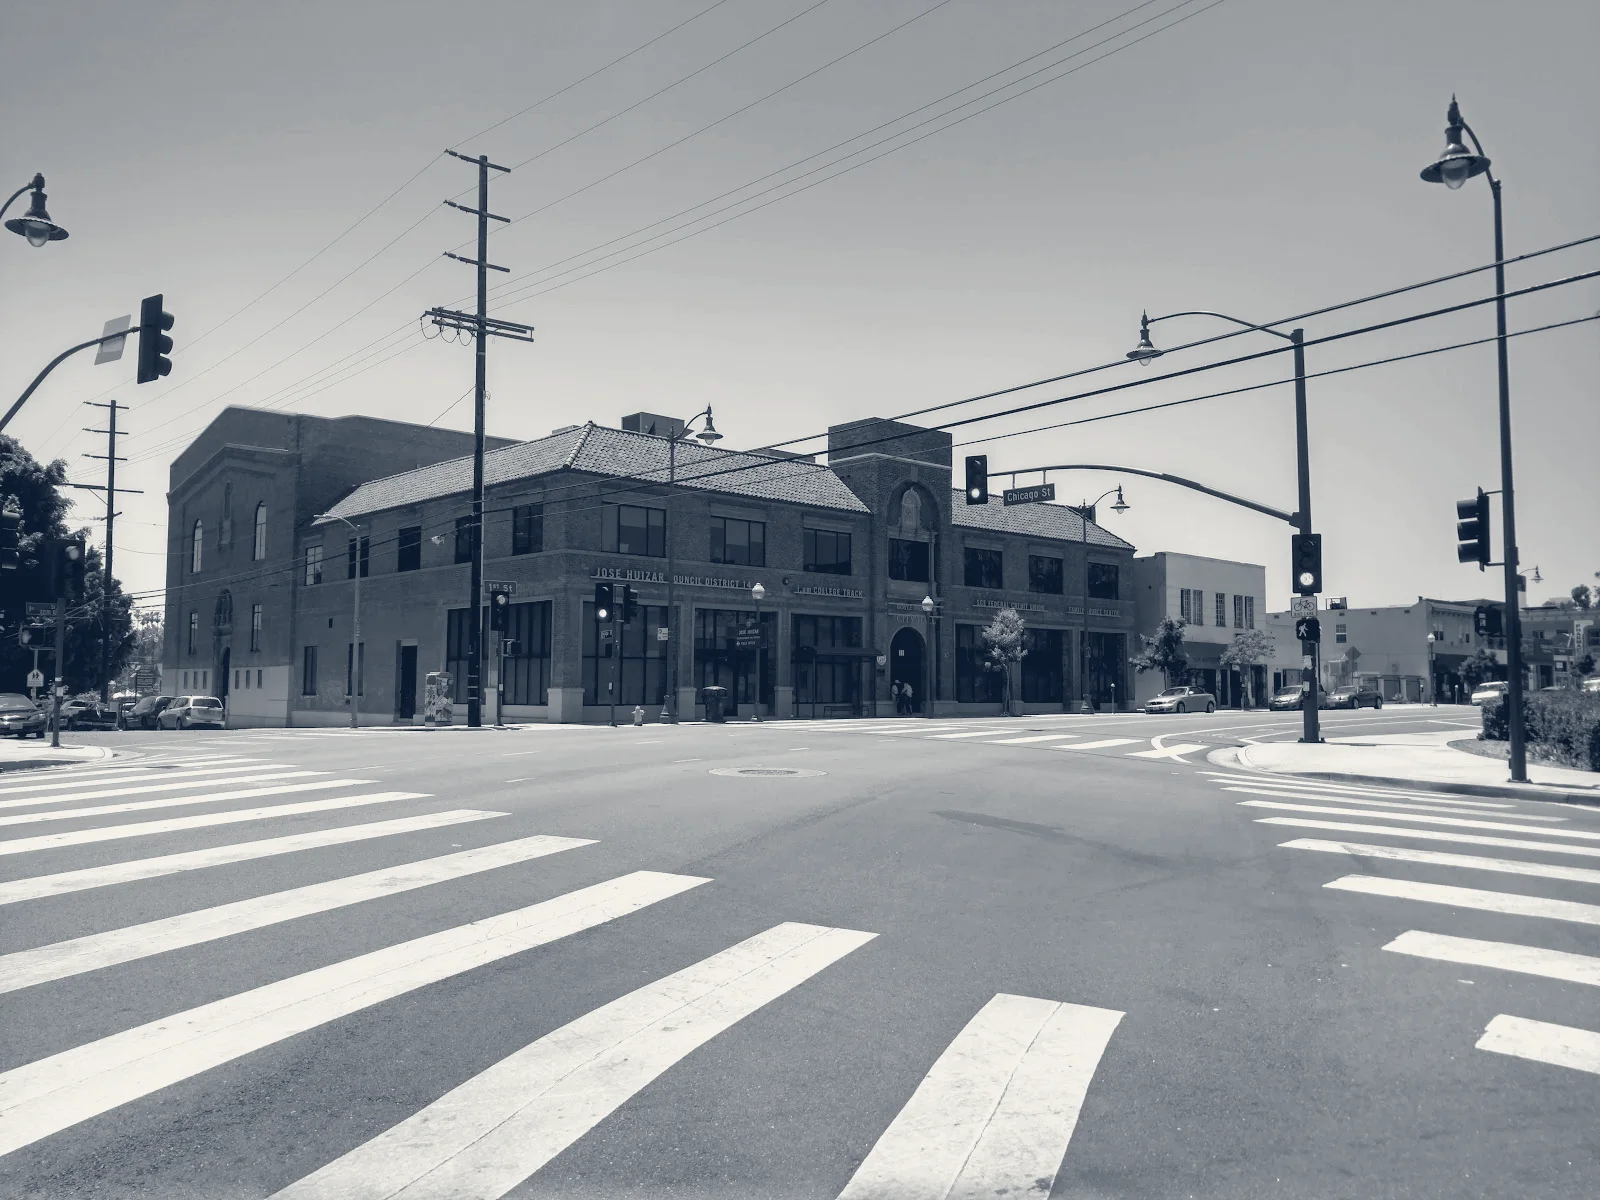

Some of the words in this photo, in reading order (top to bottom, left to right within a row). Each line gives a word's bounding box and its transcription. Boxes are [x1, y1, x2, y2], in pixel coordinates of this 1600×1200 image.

[1007, 491, 1039, 502] Chicago
[1041, 487, 1051, 497] St
[596, 567, 621, 578] JOSE
[626, 569, 664, 582] HUIZAR
[488, 583, 500, 592] 1st
[503, 584, 513, 592] St
[673, 575, 702, 585] OUNCIL
[705, 577, 740, 588] DISTRICT
[743, 580, 752, 589] 14
[813, 586, 841, 596] COLLEGE
[843, 588, 863, 598] TRACK
